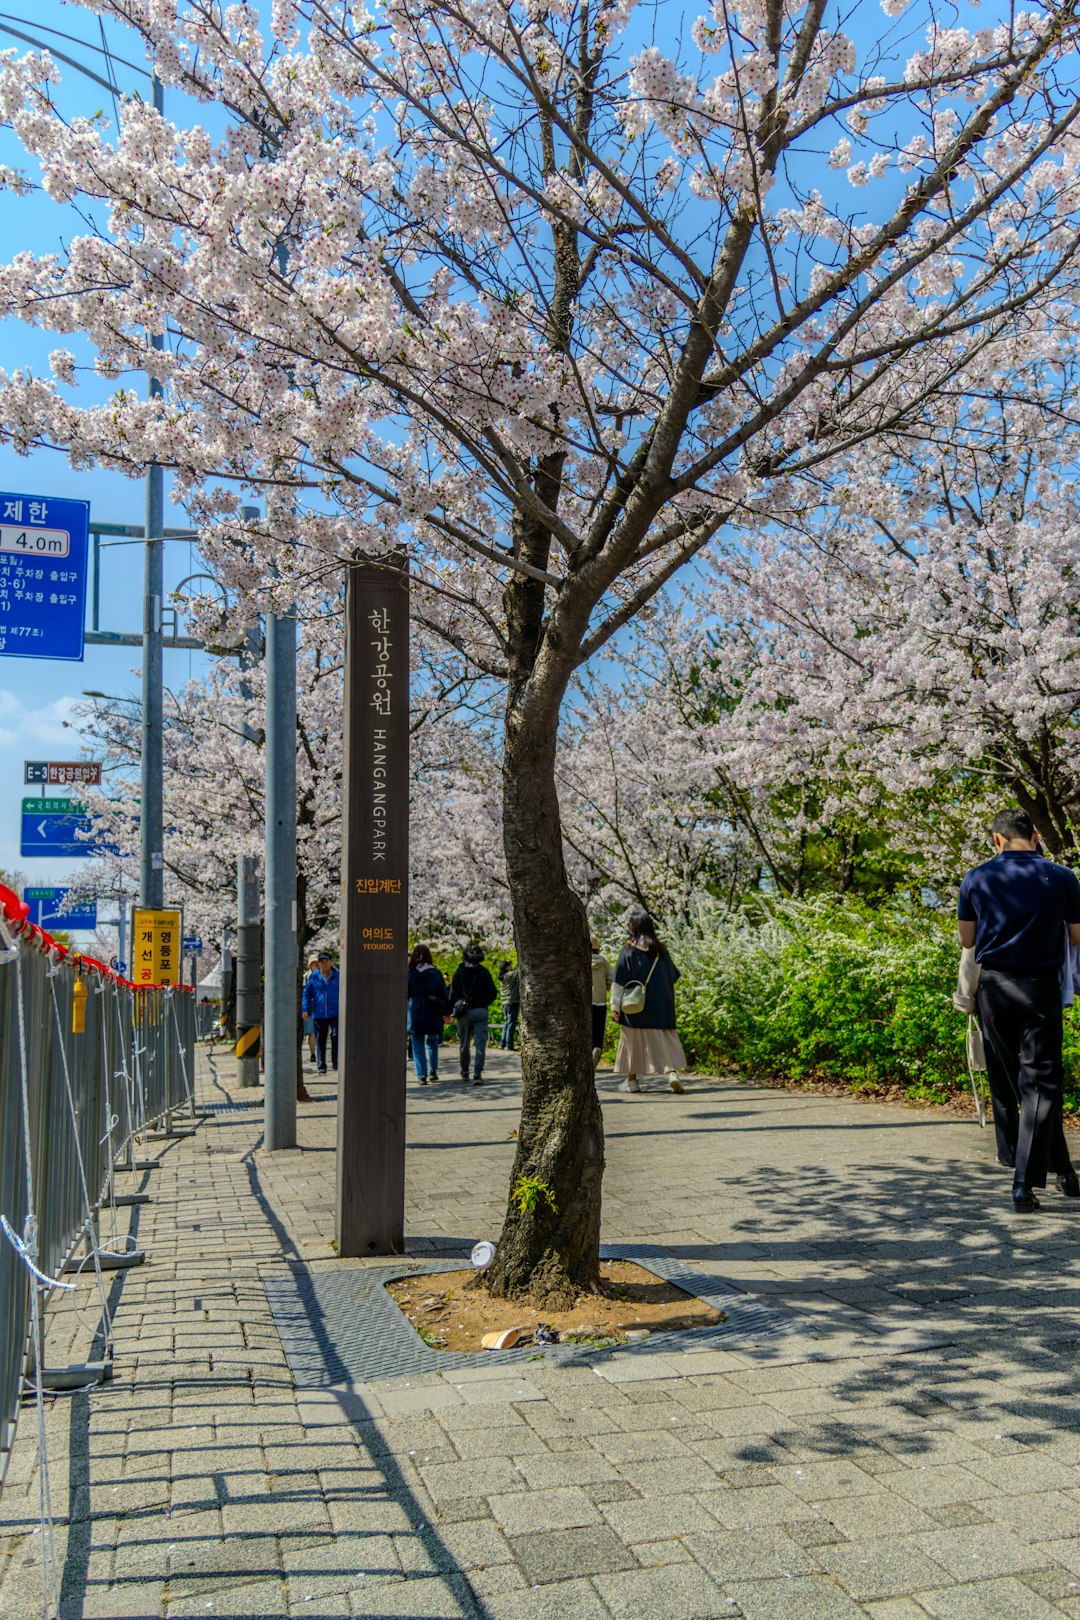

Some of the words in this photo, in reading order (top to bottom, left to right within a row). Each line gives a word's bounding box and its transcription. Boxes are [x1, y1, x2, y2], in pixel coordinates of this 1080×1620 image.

[3, 500, 48, 524] 제한
[16, 532, 62, 552] 4.0m
[15, 567, 44, 580] 주차장
[49, 570, 78, 583] 출입구
[14, 590, 44, 603] 주차장
[49, 593, 77, 605] 출입구
[368, 608, 394, 716] 한강공원
[27, 766, 48, 780] E-3
[356, 879, 402, 894] 진입계단
[362, 928, 394, 940] 여의도
